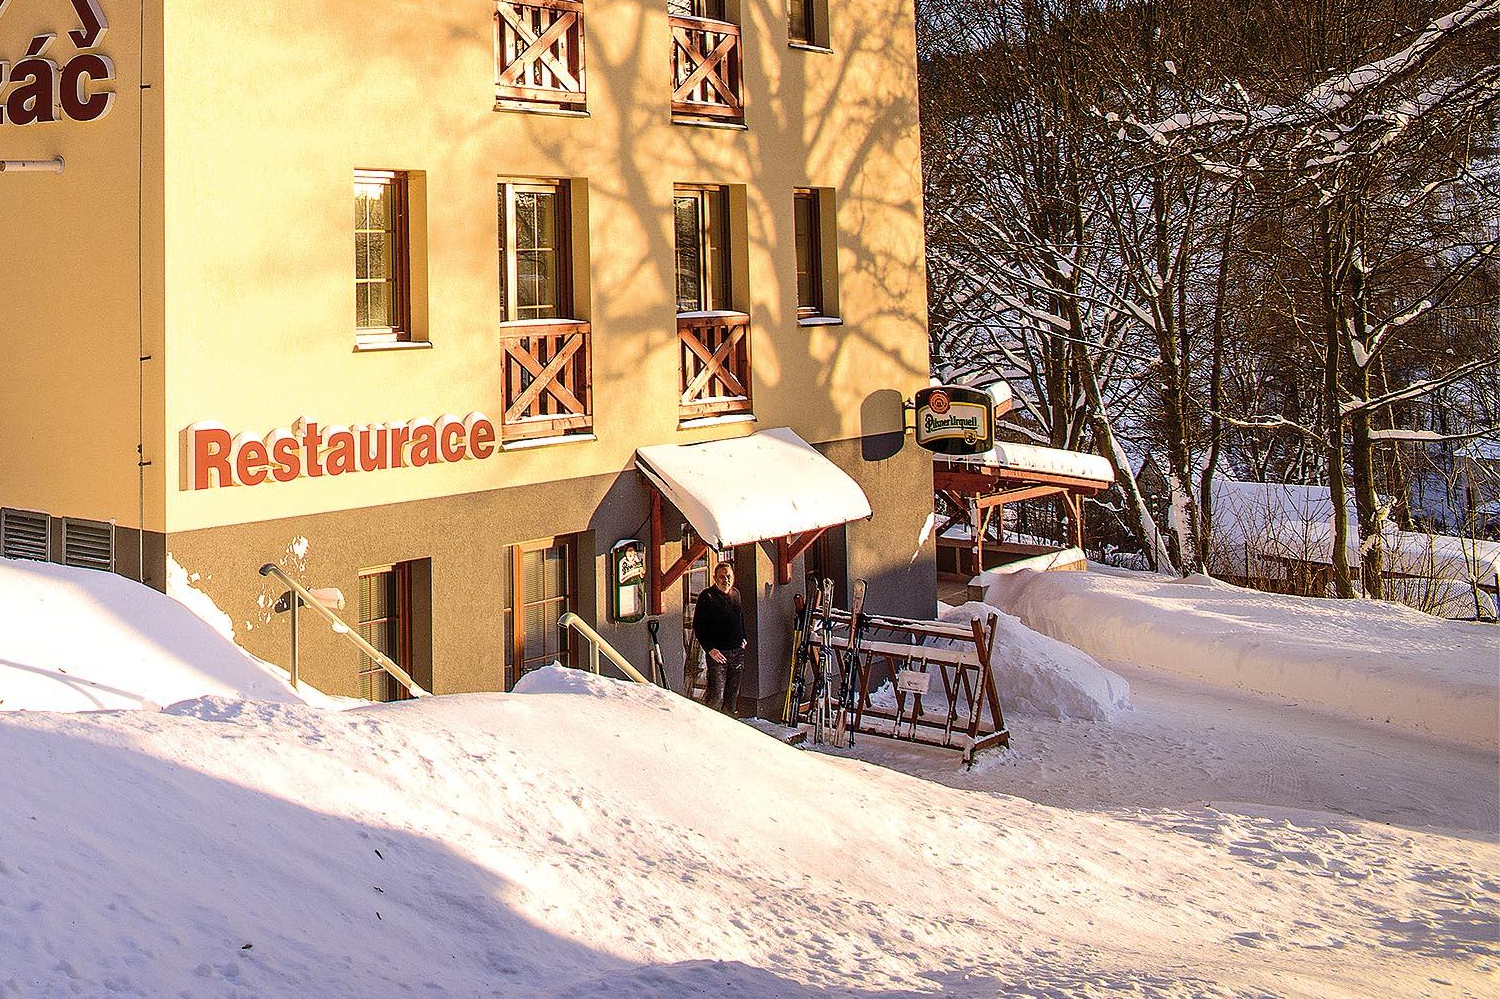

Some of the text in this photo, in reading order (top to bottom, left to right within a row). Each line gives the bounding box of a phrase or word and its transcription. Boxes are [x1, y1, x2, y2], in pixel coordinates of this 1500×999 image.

[925, 413, 977, 433] Pilsner Urquell
[193, 419, 496, 491] Restaurace
